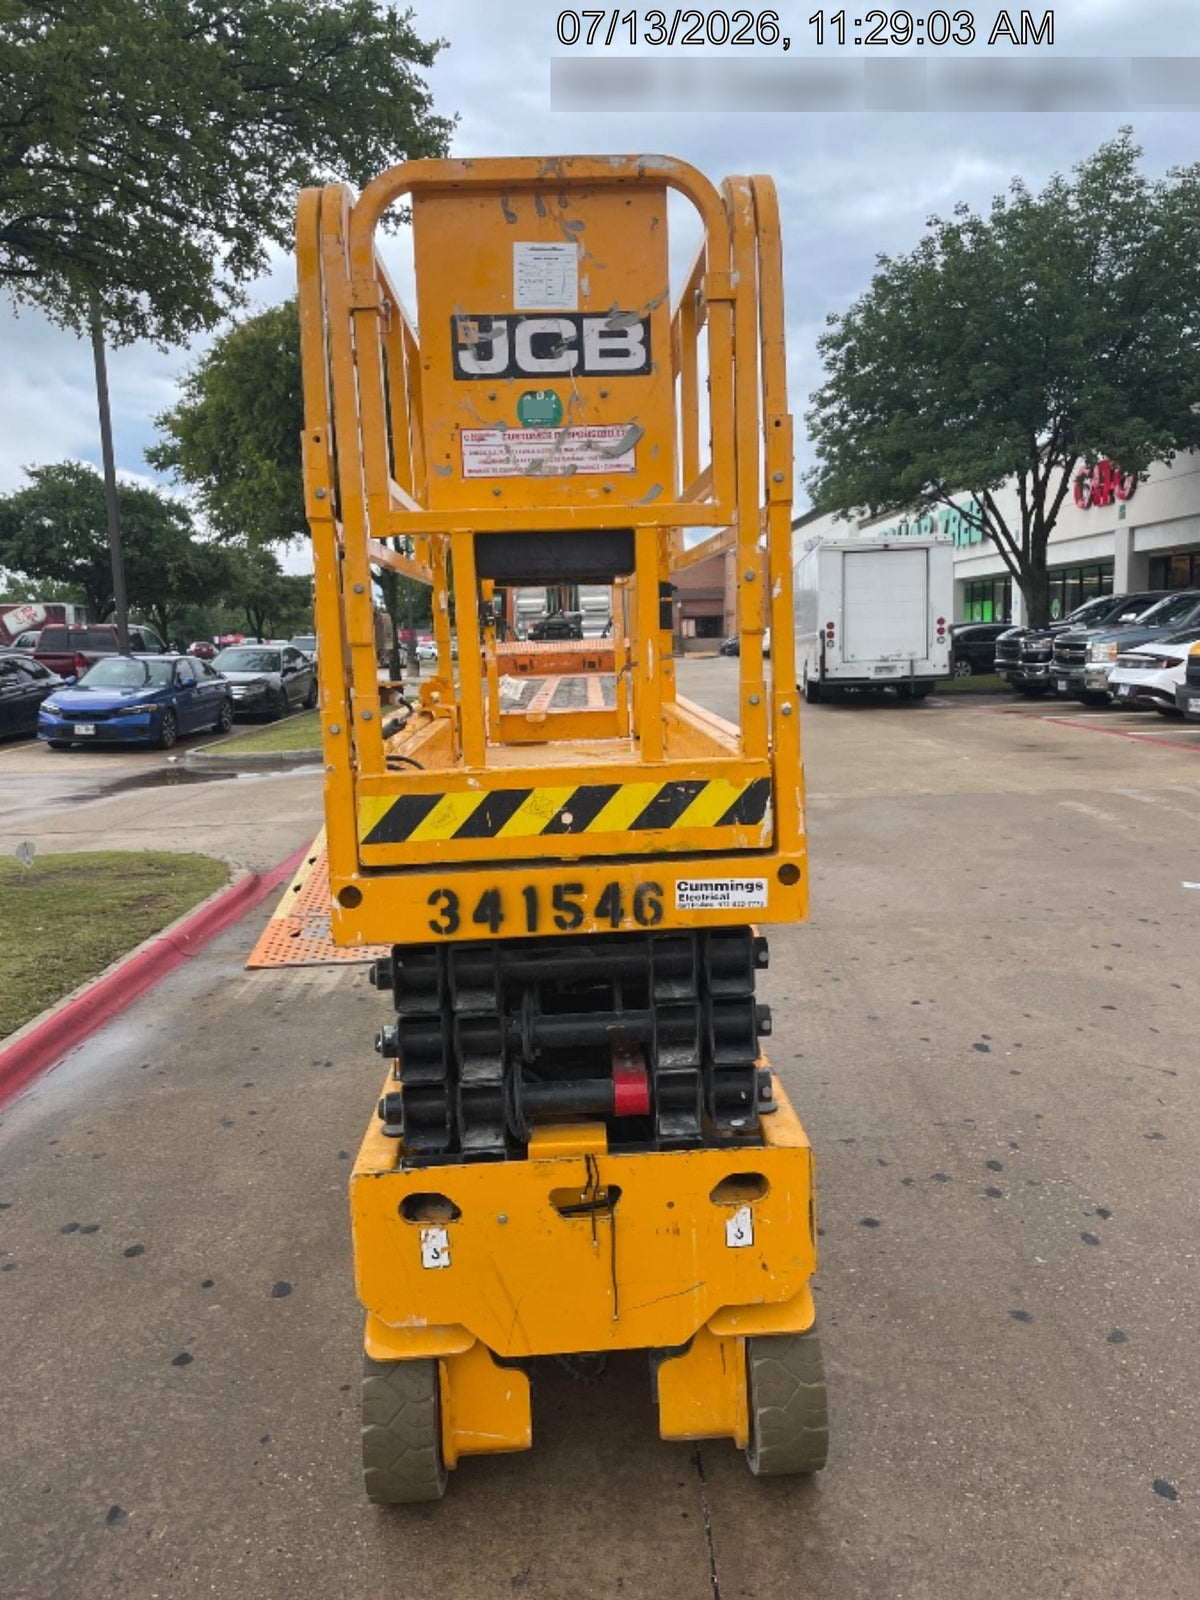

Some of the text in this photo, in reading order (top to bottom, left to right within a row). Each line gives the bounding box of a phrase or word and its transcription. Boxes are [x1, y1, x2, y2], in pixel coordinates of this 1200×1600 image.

[457, 317, 648, 375] JCB
[677, 879, 764, 893] Cummings
[678, 893, 730, 902] Electrical
[427, 881, 664, 935] 341546
